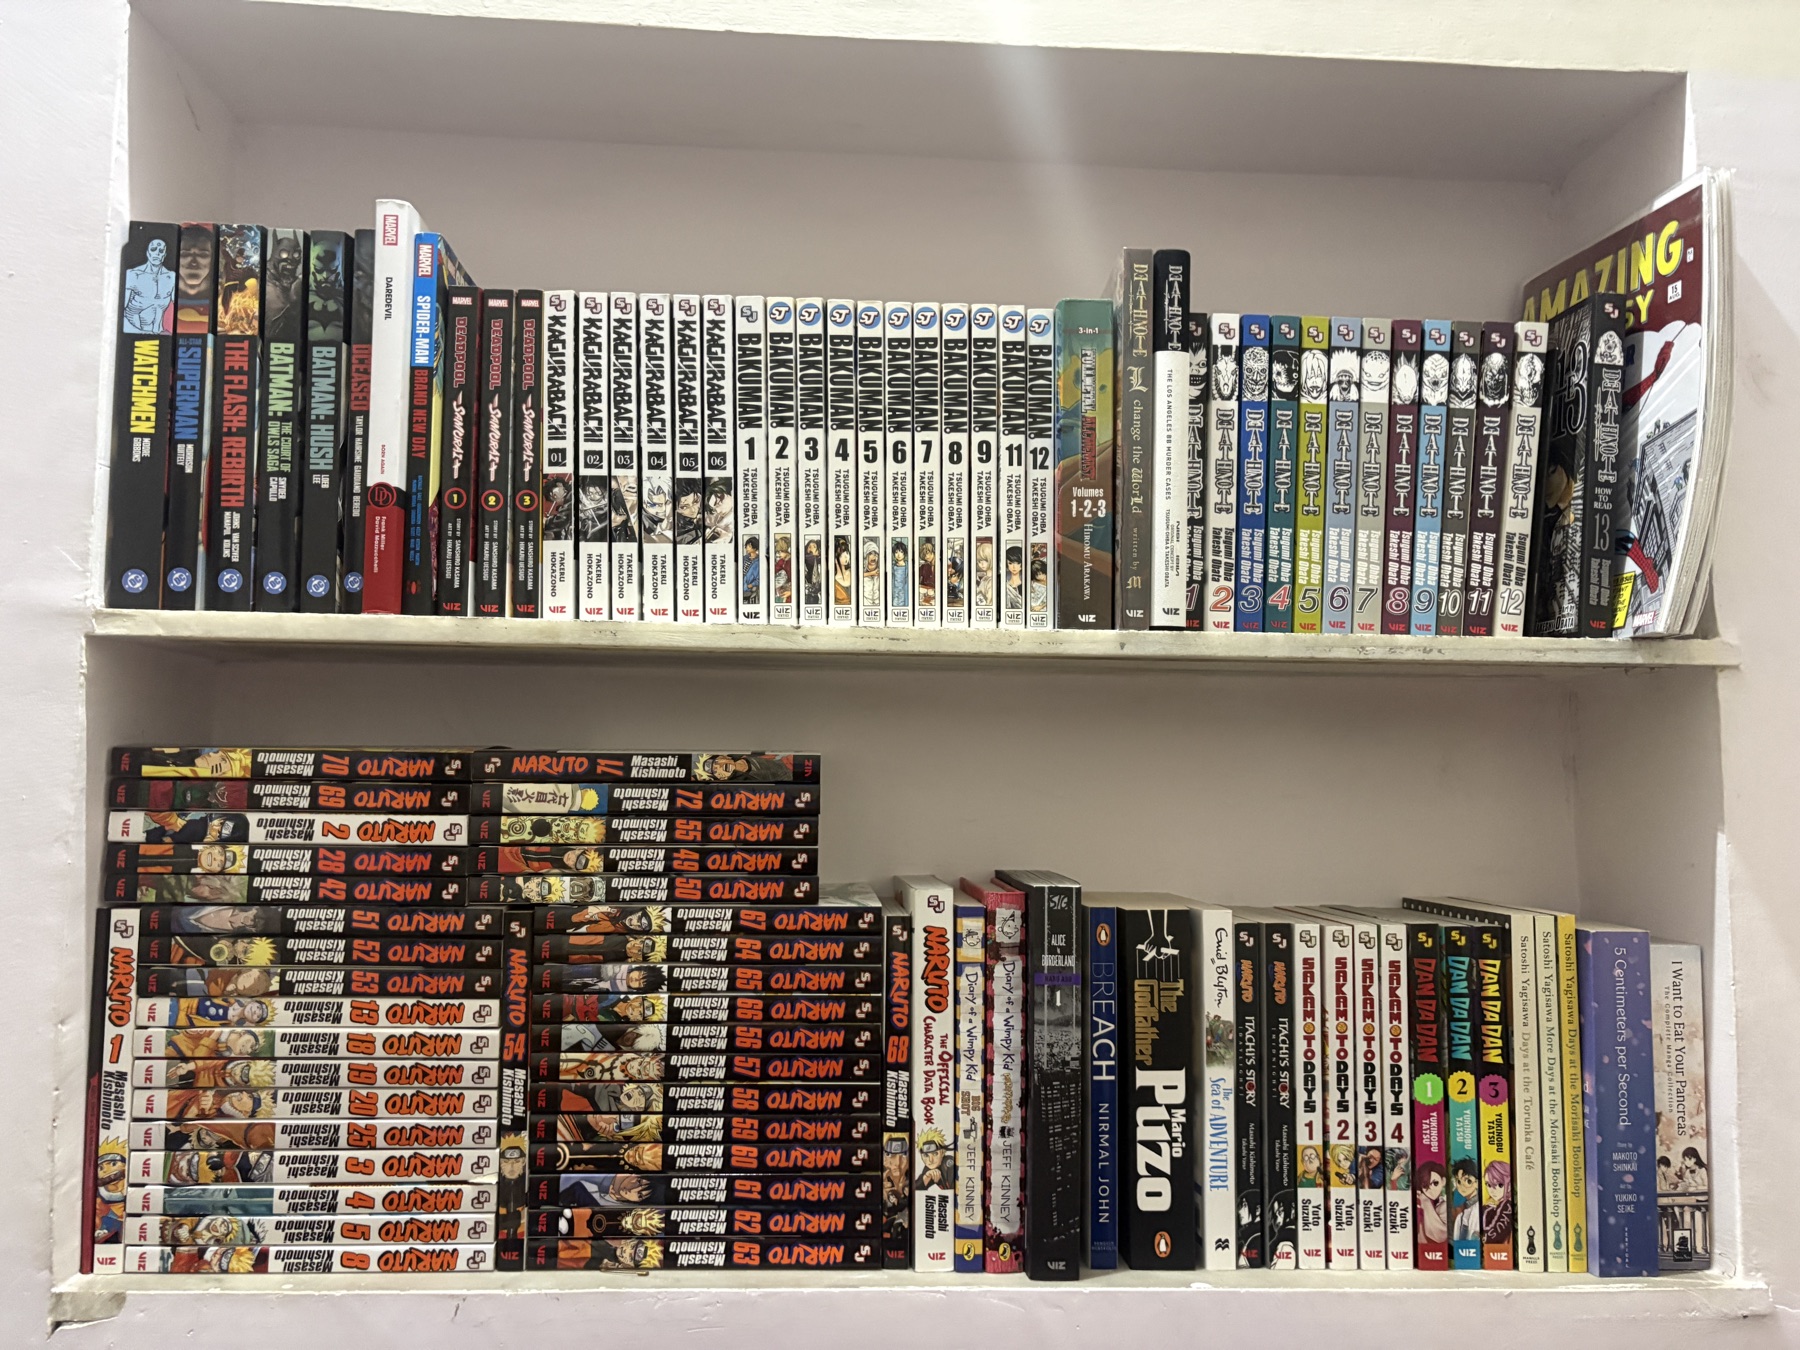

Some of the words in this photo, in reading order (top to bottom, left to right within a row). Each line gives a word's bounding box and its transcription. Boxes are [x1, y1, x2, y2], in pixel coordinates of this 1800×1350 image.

[384, 216, 398, 245] MARVEL
[418, 244, 432, 277] MARVEL
[384, 277, 393, 320] DAREDEVIL
[1671, 284, 1678, 294] 15
[415, 296, 431, 364] SPIDER-MAN
[224, 340, 249, 371] THE
[522, 319, 535, 390] DEADPOOL
[130, 340, 159, 433] WATCHMEN
[174, 347, 202, 439] SUPERMAN
[268, 342, 294, 416] BATMAN:
[310, 346, 336, 420] BATMAN:
[413, 370, 428, 406] BRAND
[583, 317, 603, 443] KAGURABACHI
[645, 319, 666, 444] KAGURABACHI
[223, 375, 248, 432] FLASH:
[268, 421, 280, 446] OWLS
[281, 421, 292, 435] THE
[412, 410, 427, 433] NEW
[1131, 400, 1144, 441] change
[267, 448, 279, 472] SAGA
[281, 437, 292, 461] COURT
[310, 424, 334, 470] HUSH
[412, 437, 426, 458] DAY
[587, 455, 599, 464] 02
[745, 437, 755, 460] 1
[775, 436, 789, 459] 2
[835, 438, 849, 461] 4
[921, 440, 932, 463] 7
[1030, 446, 1049, 470] 12
[1132, 447, 1140, 464] the
[220, 436, 246, 507] REBIRTH
[280, 463, 291, 472] OF
[524, 496, 530, 505] 3
[1072, 487, 1104, 497] Volumes
[1594, 501, 1613, 510] READ
[1071, 500, 1106, 518] 1-2-3
[1083, 523, 1093, 559] HIROMU
[1212, 527, 1222, 558] Takeshi
[1223, 527, 1234, 560] Tsugumi
[1593, 513, 1610, 550] 13
[1083, 561, 1093, 600] ARAKAWA
[1212, 559, 1222, 582] Obata
[1224, 561, 1234, 582] Ohba
[1210, 584, 1234, 612] 2
[1328, 584, 1350, 612] 6
[1439, 588, 1462, 616] 10
[257, 753, 315, 764] Kishimoto
[265, 764, 314, 776] Masashi
[322, 754, 350, 775] 70
[357, 757, 434, 777] NARUTO
[512, 755, 589, 775] NARUTO
[596, 759, 623, 776] 71
[631, 756, 678, 767] Masashi
[631, 767, 686, 778] Kishimoto
[676, 789, 703, 810] 72
[710, 791, 785, 810] NARUTO
[1051, 934, 1066, 946] ALICE
[1215, 927, 1228, 960] Enid
[1564, 933, 1575, 971] Satoshi
[921, 926, 951, 1013] NARUTO
[1042, 955, 1074, 966] BORDERLAND
[107, 947, 135, 1027] NARUTO
[890, 952, 910, 1028] NARUTO
[965, 972, 978, 1004] Diary
[1055, 990, 1061, 1006] 1
[1160, 978, 1184, 1013] The
[1213, 964, 1228, 1008] Blyton
[1672, 968, 1683, 1001] Want
[968, 1007, 977, 1016] of
[1302, 957, 1316, 1060] SAKAMOTO
[1564, 976, 1575, 1024] Yagisawa
[1614, 960, 1628, 1042] Centimeters
[1673, 1005, 1683, 1019] to
[1092, 962, 1115, 1080] BREACH
[1134, 979, 1160, 1065] Godfather
[1674, 1022, 1685, 1042] Eat
[109, 1034, 124, 1063] 1
[887, 1036, 909, 1063] 68
[923, 1016, 936, 1066] CHARACTER
[940, 1034, 948, 1049] THE
[964, 1026, 977, 1062] Wimpy
[1245, 1016, 1256, 1066] ITACHI'S
[1566, 1029, 1577, 1054] Days
[1569, 1059, 1577, 1069] at
[1615, 1046, 1627, 1069] per
[1675, 1046, 1686, 1076] Your
[924, 1069, 936, 1093] DATA
[938, 1051, 953, 1106] OFFICIAL
[965, 1064, 978, 1081] Kid
[1570, 1074, 1579, 1090] the
[1210, 1077, 1226, 1100] Sea
[1223, 1087, 1233, 1101] The
[1245, 1069, 1256, 1107] STORY
[1303, 1061, 1316, 1113] DAYS
[1456, 1079, 1468, 1095] 2
[1617, 1073, 1631, 1126] Second
[921, 1097, 936, 1125] BOOK
[1211, 1101, 1225, 1114] of
[1570, 1094, 1580, 1141] Morisaki
[1676, 1080, 1686, 1136] Pancreas
[347, 1122, 377, 1148] 25
[384, 1124, 465, 1147] NARUTO
[1098, 1103, 1110, 1169] NIRMAL
[1136, 1066, 1186, 1212] Puzo
[1171, 1109, 1186, 1158] Mario
[1304, 1120, 1314, 1140] 1
[967, 1144, 975, 1171] JEFF
[1209, 1113, 1229, 1192] ADVENTURE
[1571, 1146, 1582, 1198] Bookshop
[965, 1176, 975, 1221] KINNEY
[1098, 1177, 1110, 1223] JOHN
[1617, 1205, 1635, 1213] SEIKE
[1302, 1198, 1312, 1231] Suzuki
[1311, 1203, 1321, 1226] Yuto
